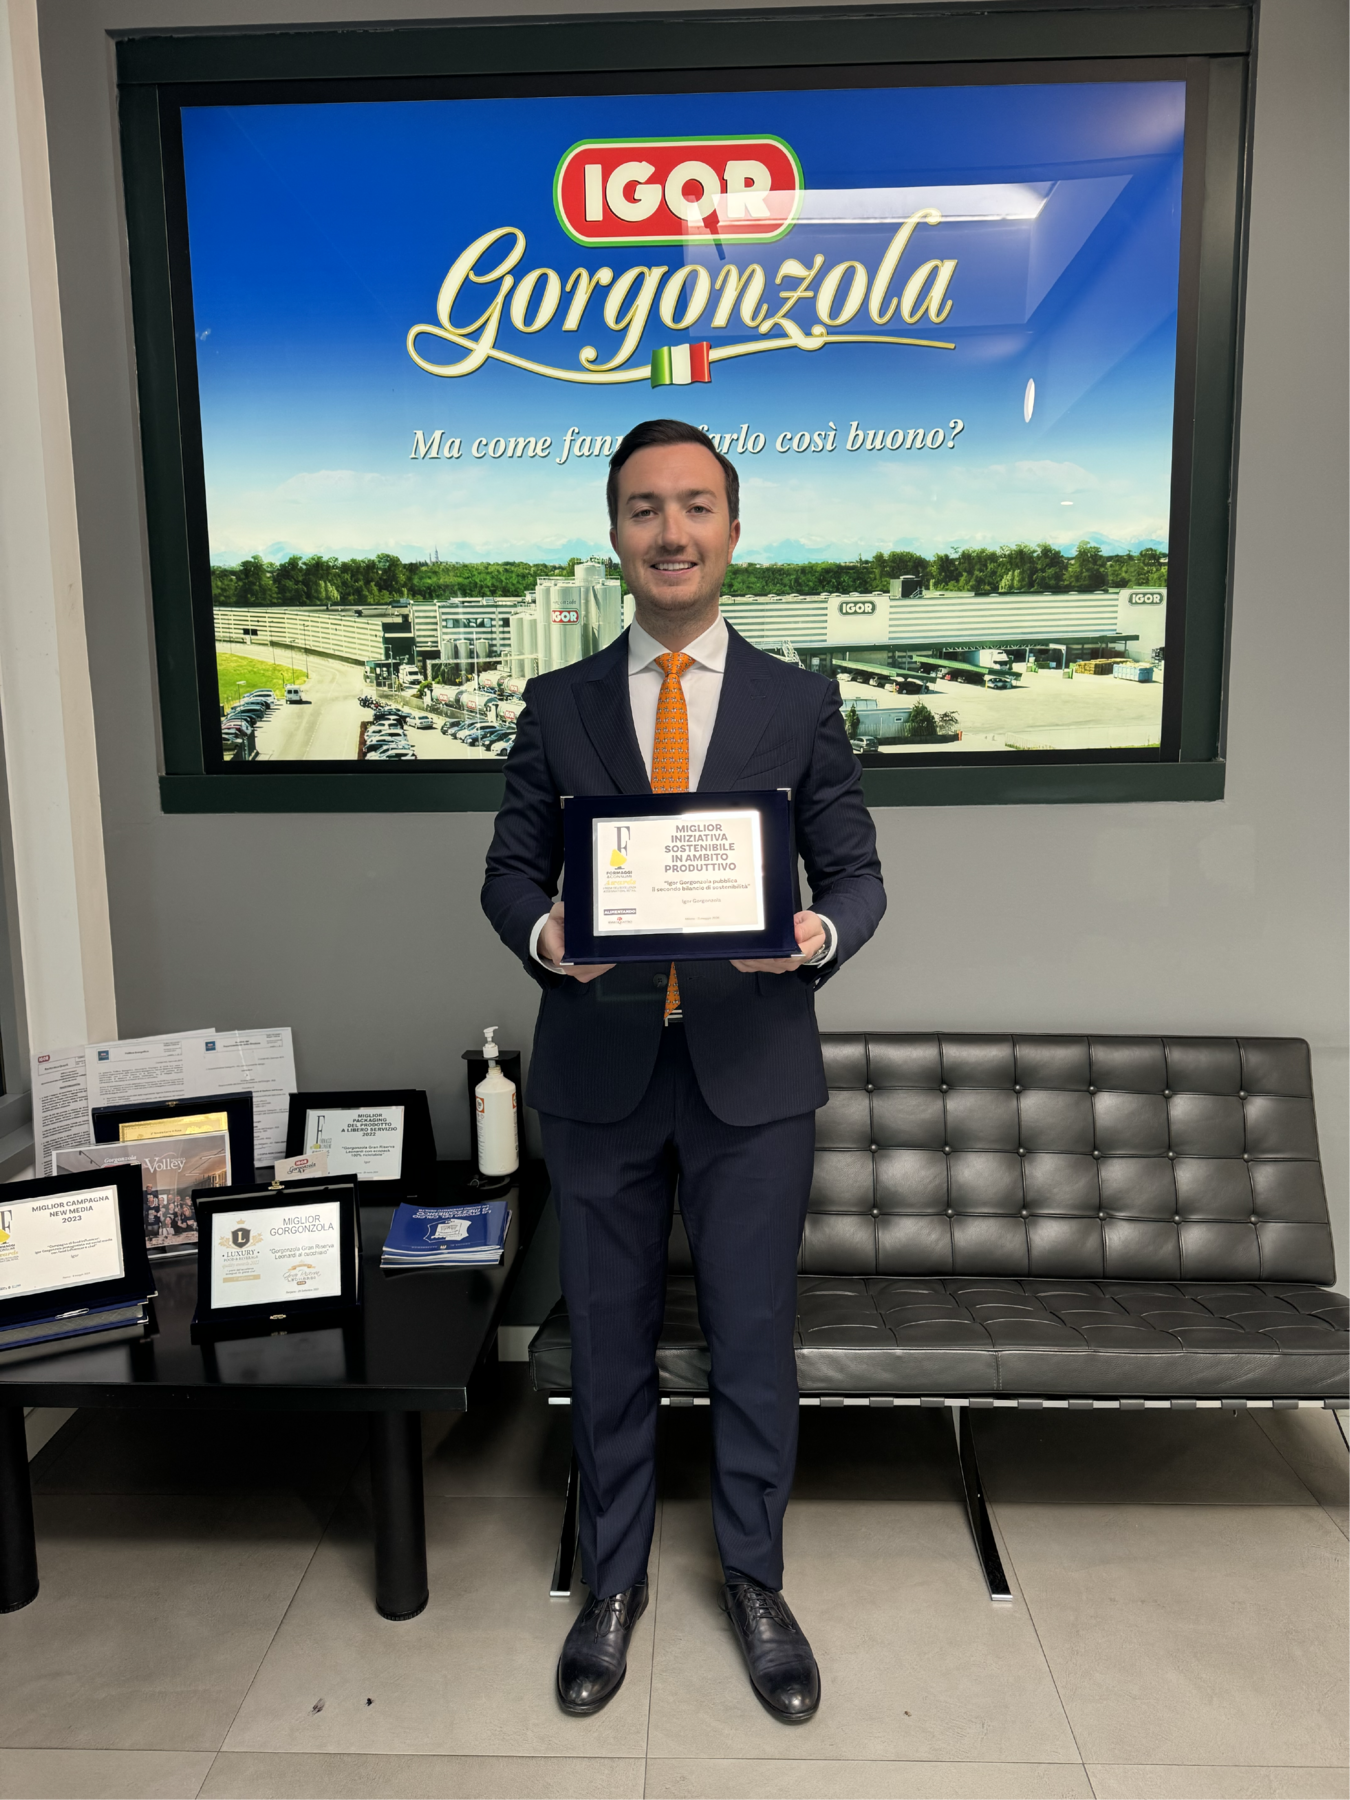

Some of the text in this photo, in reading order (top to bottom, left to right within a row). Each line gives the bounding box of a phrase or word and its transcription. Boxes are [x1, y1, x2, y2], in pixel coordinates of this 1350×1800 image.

[584, 159, 771, 222] IGOR
[406, 207, 959, 383] Gorgonzola
[409, 418, 965, 465] Ma come fan arlo così buono?
[1131, 593, 1161, 604] IGOR
[842, 602, 872, 614] IGOR
[676, 824, 723, 834] MIGLIOR
[671, 833, 728, 844] INIZIATIVA
[664, 842, 736, 854] SOSTENIBILE
[672, 852, 729, 863] IN AMBITO
[664, 862, 737, 873] PRODUTTIVO
[104, 1155, 137, 1163] Gorgonzola
[144, 1157, 186, 1174] Volley
[32, 1196, 110, 1212] MIGLIOR CAMPAGNA
[50, 1206, 93, 1218] NEW MEDIA
[62, 1215, 82, 1224] 2023
[282, 1214, 321, 1226] MIGLIOR
[270, 1222, 334, 1236] GORGONZOLA
[238, 1232, 246, 1243] L
[226, 1249, 256, 1258] LUXURY
